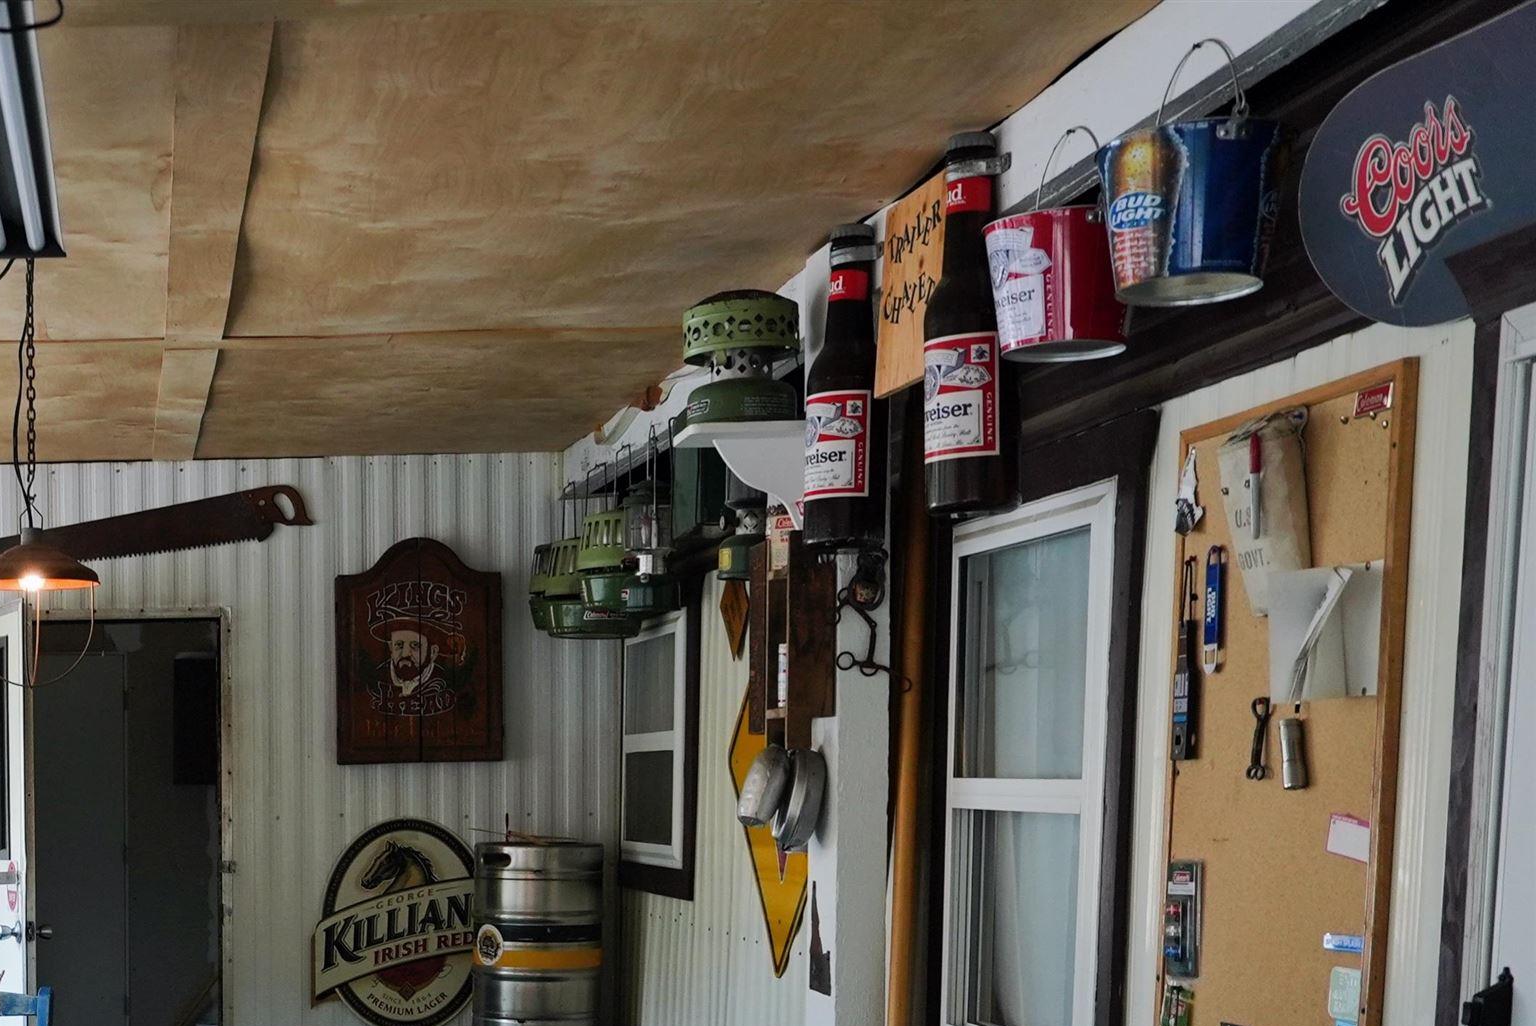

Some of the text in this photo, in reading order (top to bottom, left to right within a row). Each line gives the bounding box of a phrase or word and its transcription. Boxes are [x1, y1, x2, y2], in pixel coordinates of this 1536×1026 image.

[1343, 97, 1470, 236] Coors
[1112, 206, 1165, 226] LIGHT
[1116, 194, 1162, 212] BUD
[888, 200, 941, 264] TRAILER
[1379, 157, 1484, 302] LIGHT
[884, 272, 935, 324] CHALET
[366, 580, 466, 626] KINGS
[375, 888, 436, 910] GEORGE
[373, 938, 429, 966] IRISH
[437, 931, 474, 950] RED
[366, 992, 448, 1016] PREMIUM LAGER
